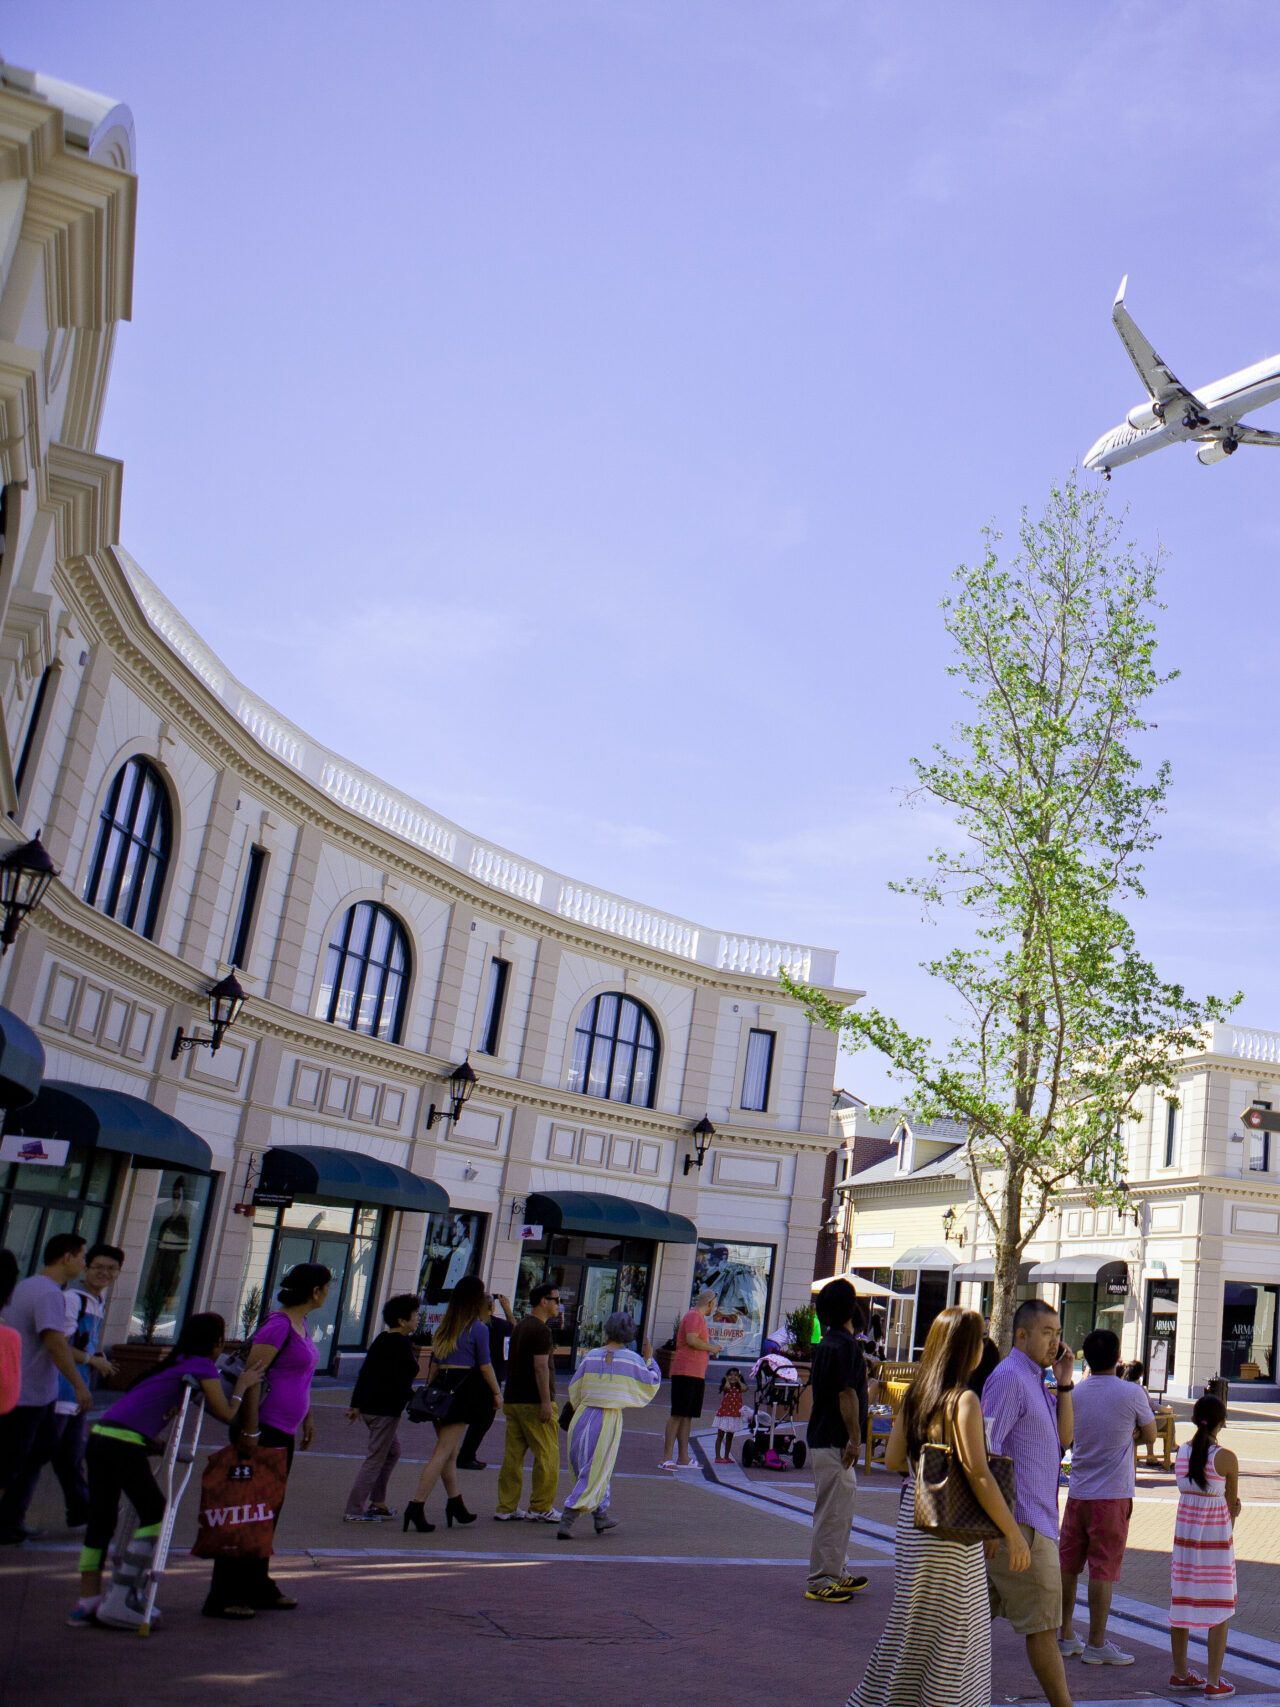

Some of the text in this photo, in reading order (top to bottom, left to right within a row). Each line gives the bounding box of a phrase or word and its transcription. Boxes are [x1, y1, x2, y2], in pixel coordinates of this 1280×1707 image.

[1154, 1320, 1176, 1331] ARMANI
[720, 1328, 744, 1338] LOVERS
[205, 1503, 274, 1528] WILL
